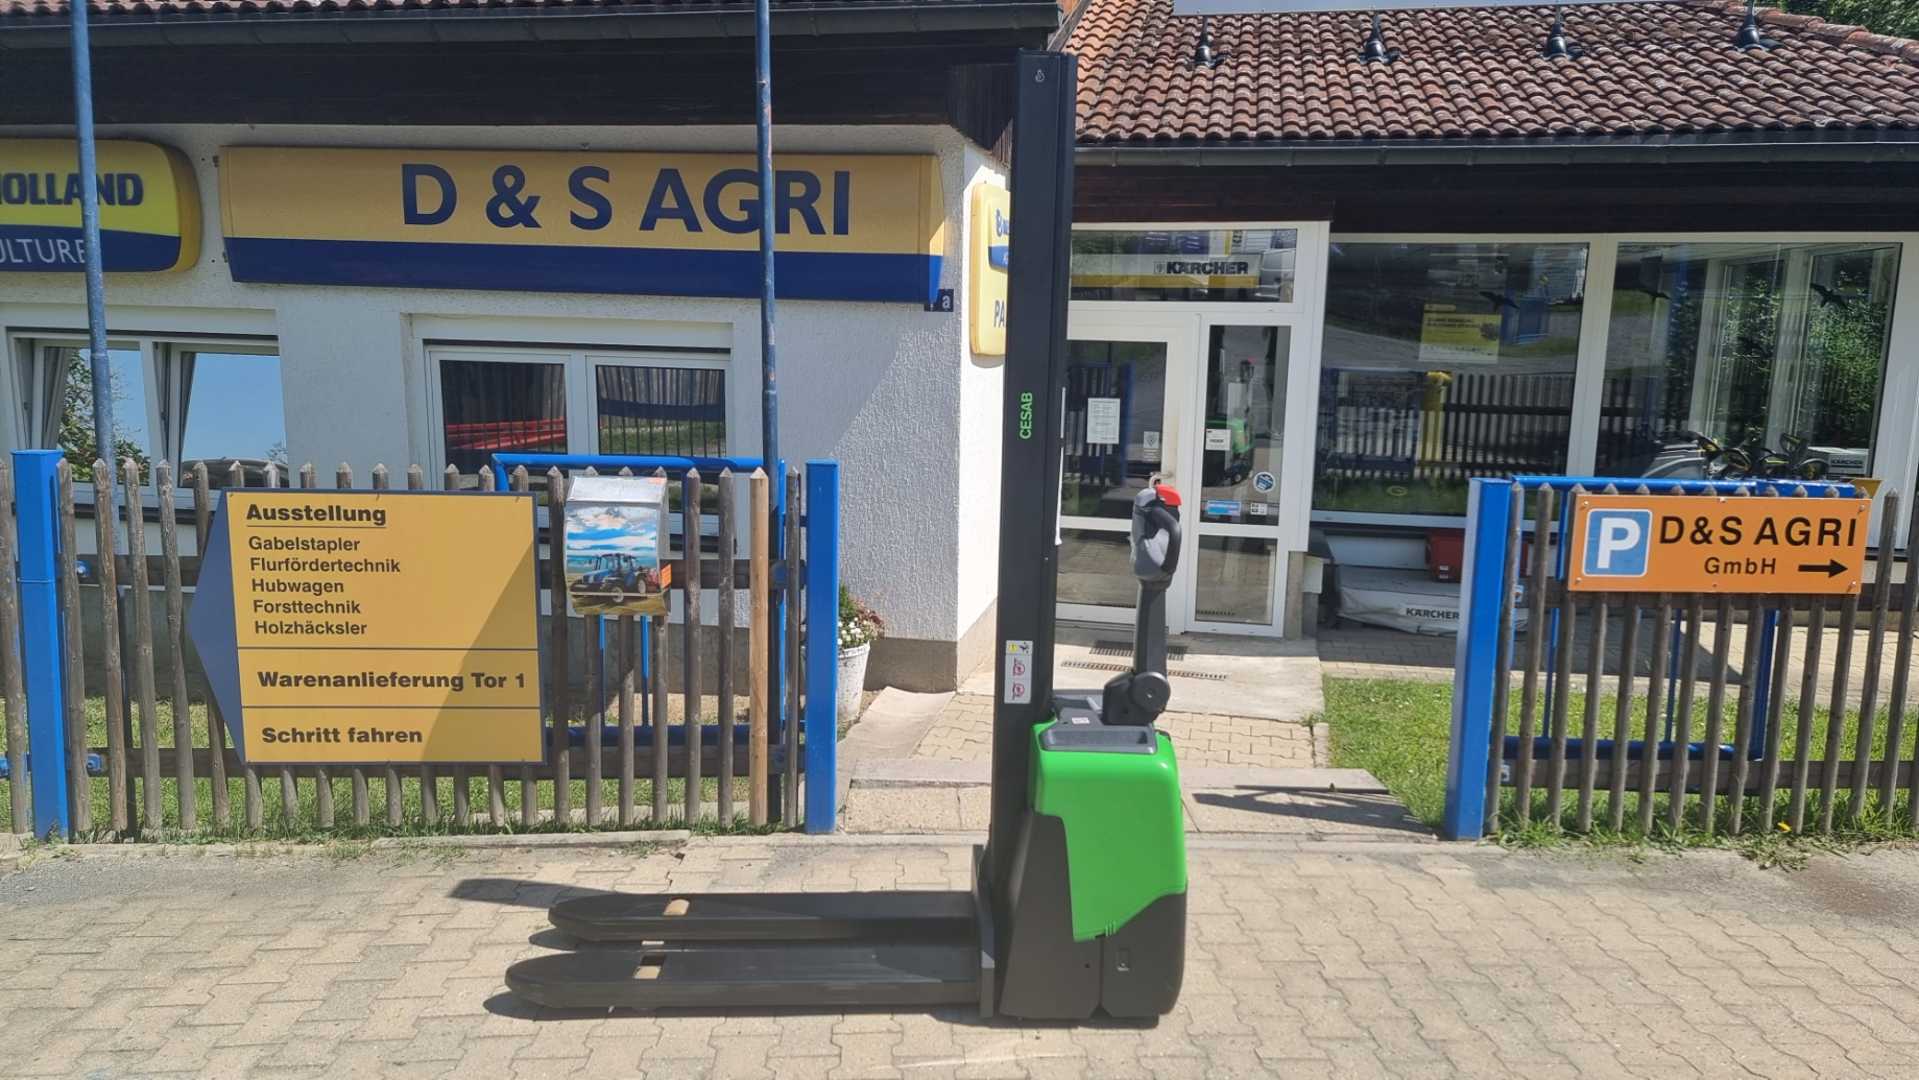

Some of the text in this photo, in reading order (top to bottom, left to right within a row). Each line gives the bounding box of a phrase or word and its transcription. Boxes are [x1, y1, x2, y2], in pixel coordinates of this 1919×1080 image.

[0, 172, 144, 206] OLLAND
[401, 163, 850, 236] D & S AGRI
[1020, 392, 1033, 440] CESAB
[246, 503, 387, 526] Ausstellung
[1659, 515, 1744, 546] D&S
[1753, 516, 1858, 548] AGRI
[248, 535, 361, 554] Gabelstapler
[250, 556, 401, 573] Flurfördertechnik
[1703, 556, 1778, 576] GmbH
[251, 577, 345, 597] Hubwagen
[253, 598, 361, 614] Forsttechnik
[254, 619, 368, 636] Holzhäcksler
[257, 670, 526, 692] Warenanlieferung Tor 1
[261, 726, 423, 744] Schritt fahren
